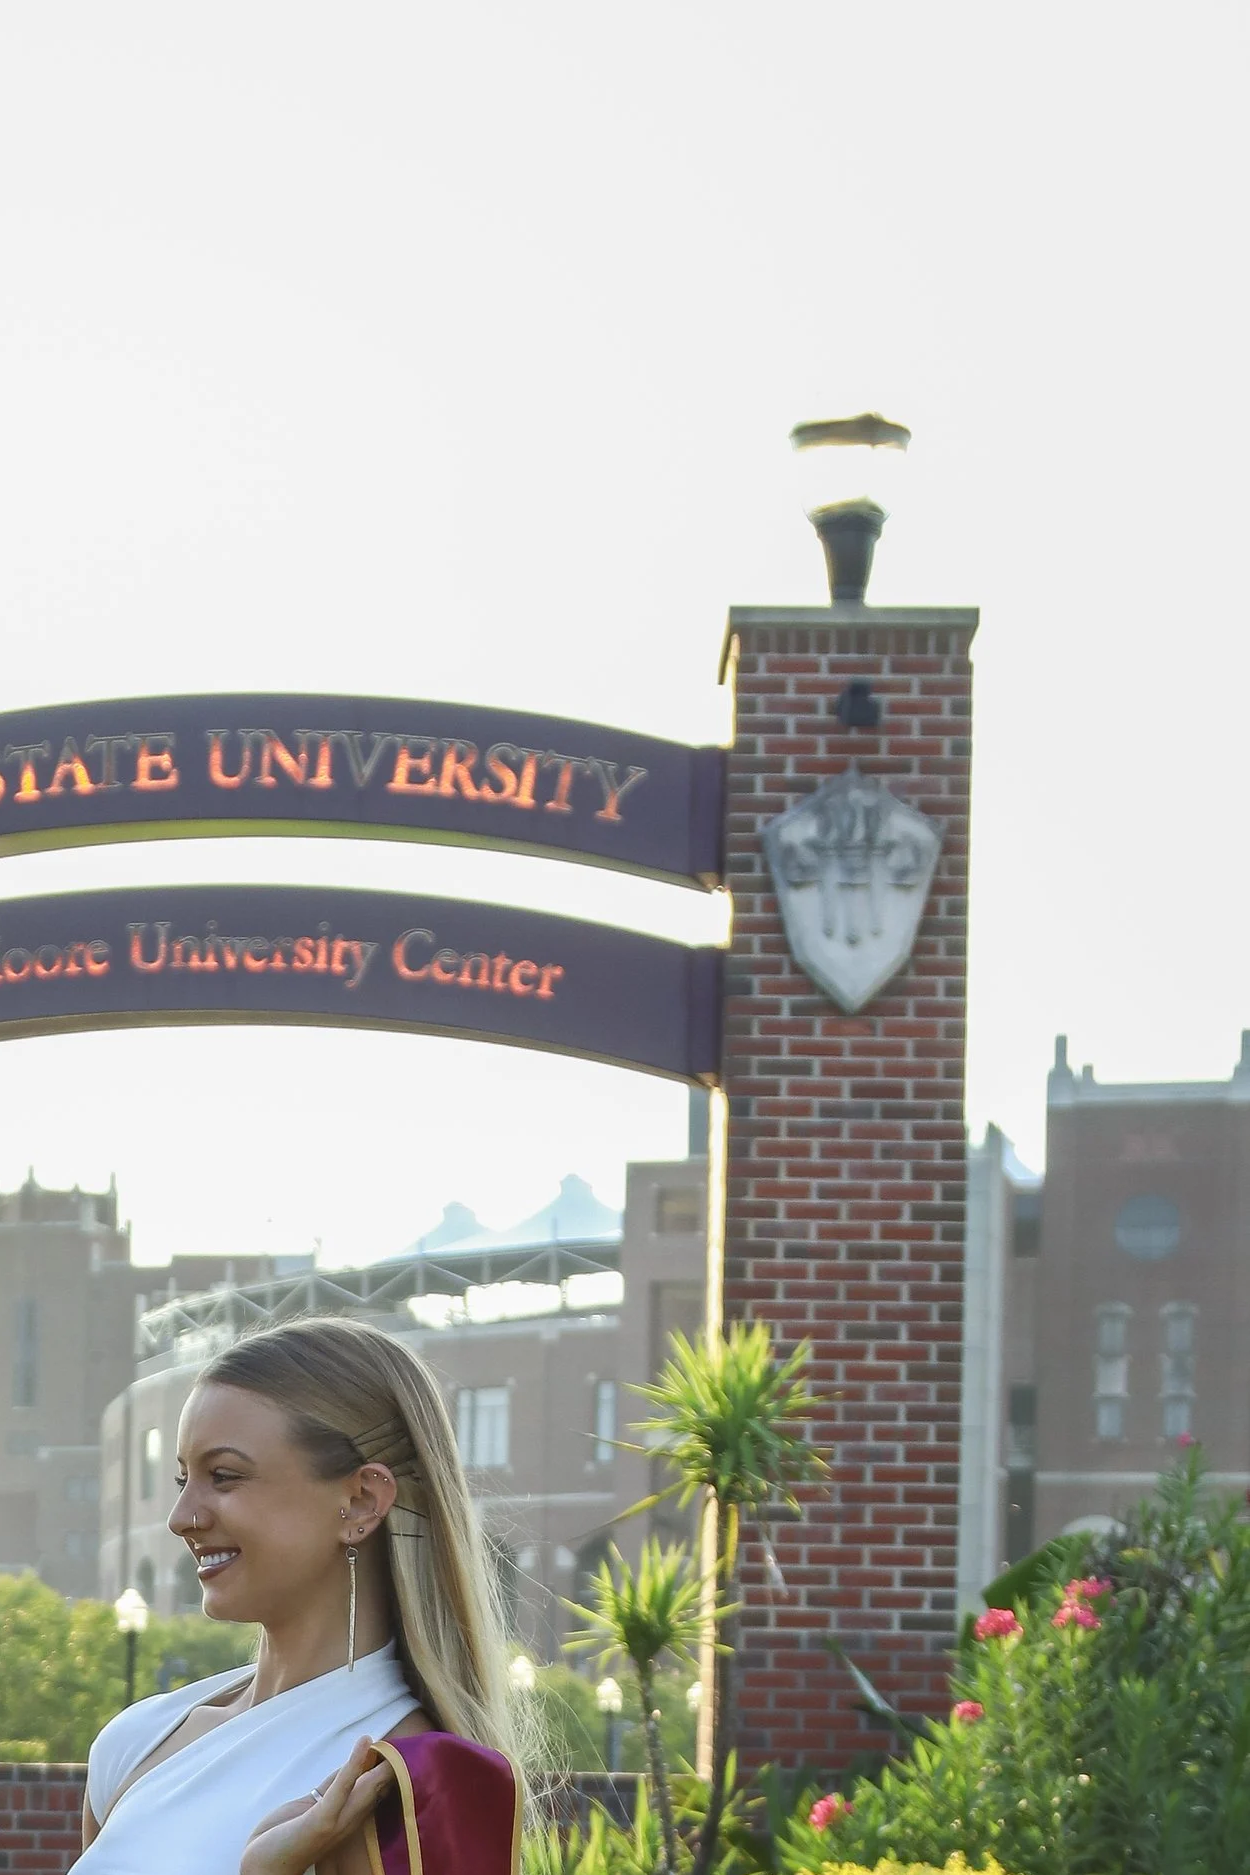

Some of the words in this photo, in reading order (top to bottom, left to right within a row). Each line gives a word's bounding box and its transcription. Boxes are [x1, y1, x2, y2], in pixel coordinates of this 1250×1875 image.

[206, 729, 647, 823] UNIVERSITY
[127, 921, 379, 987] University
[392, 928, 565, 1000] Center
